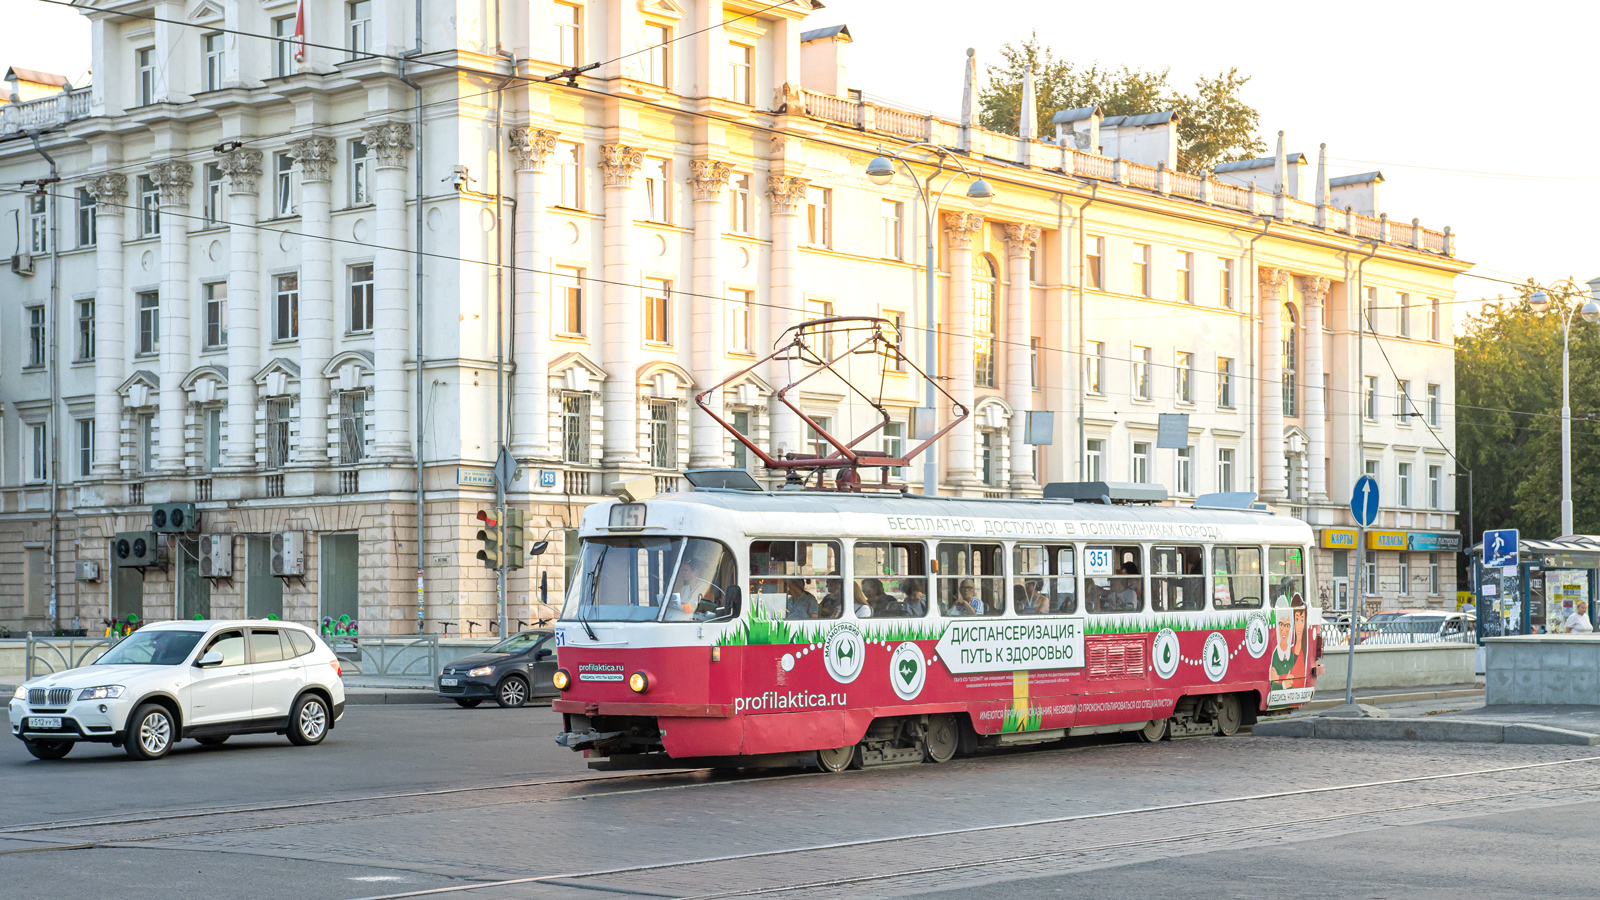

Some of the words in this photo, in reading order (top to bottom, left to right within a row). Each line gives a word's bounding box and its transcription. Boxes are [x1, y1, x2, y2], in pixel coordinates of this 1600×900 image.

[545, 473, 554, 483] 58
[887, 517, 976, 532] БЕСПЛАТНО!
[984, 520, 1058, 535] ДОСТУПНО!
[1064, 523, 1076, 534] В
[1080, 523, 1177, 537] ПОЛИКЛИНИКАХ
[1179, 525, 1224, 539] ГОРОДА
[1331, 533, 1354, 545] КАРТЫ
[1378, 535, 1404, 546] АТЛАСЫ
[1090, 551, 1108, 567] 351
[556, 632, 565, 646] 51
[825, 624, 860, 658] МАММОГРАФИЯ
[951, 624, 1074, 645] ДИСПАНСЕРИЗАЦИЯ
[896, 642, 910, 656] ЭКГ
[961, 648, 992, 664] ПУТЬ
[996, 647, 1004, 662] К
[1006, 645, 1073, 664] ЗДОРОВЬЮ
[579, 664, 624, 673] profilaktica.ru
[735, 690, 847, 714] profilaktica.ru
[979, 710, 1004, 720] ИМЕЮТСЯ
